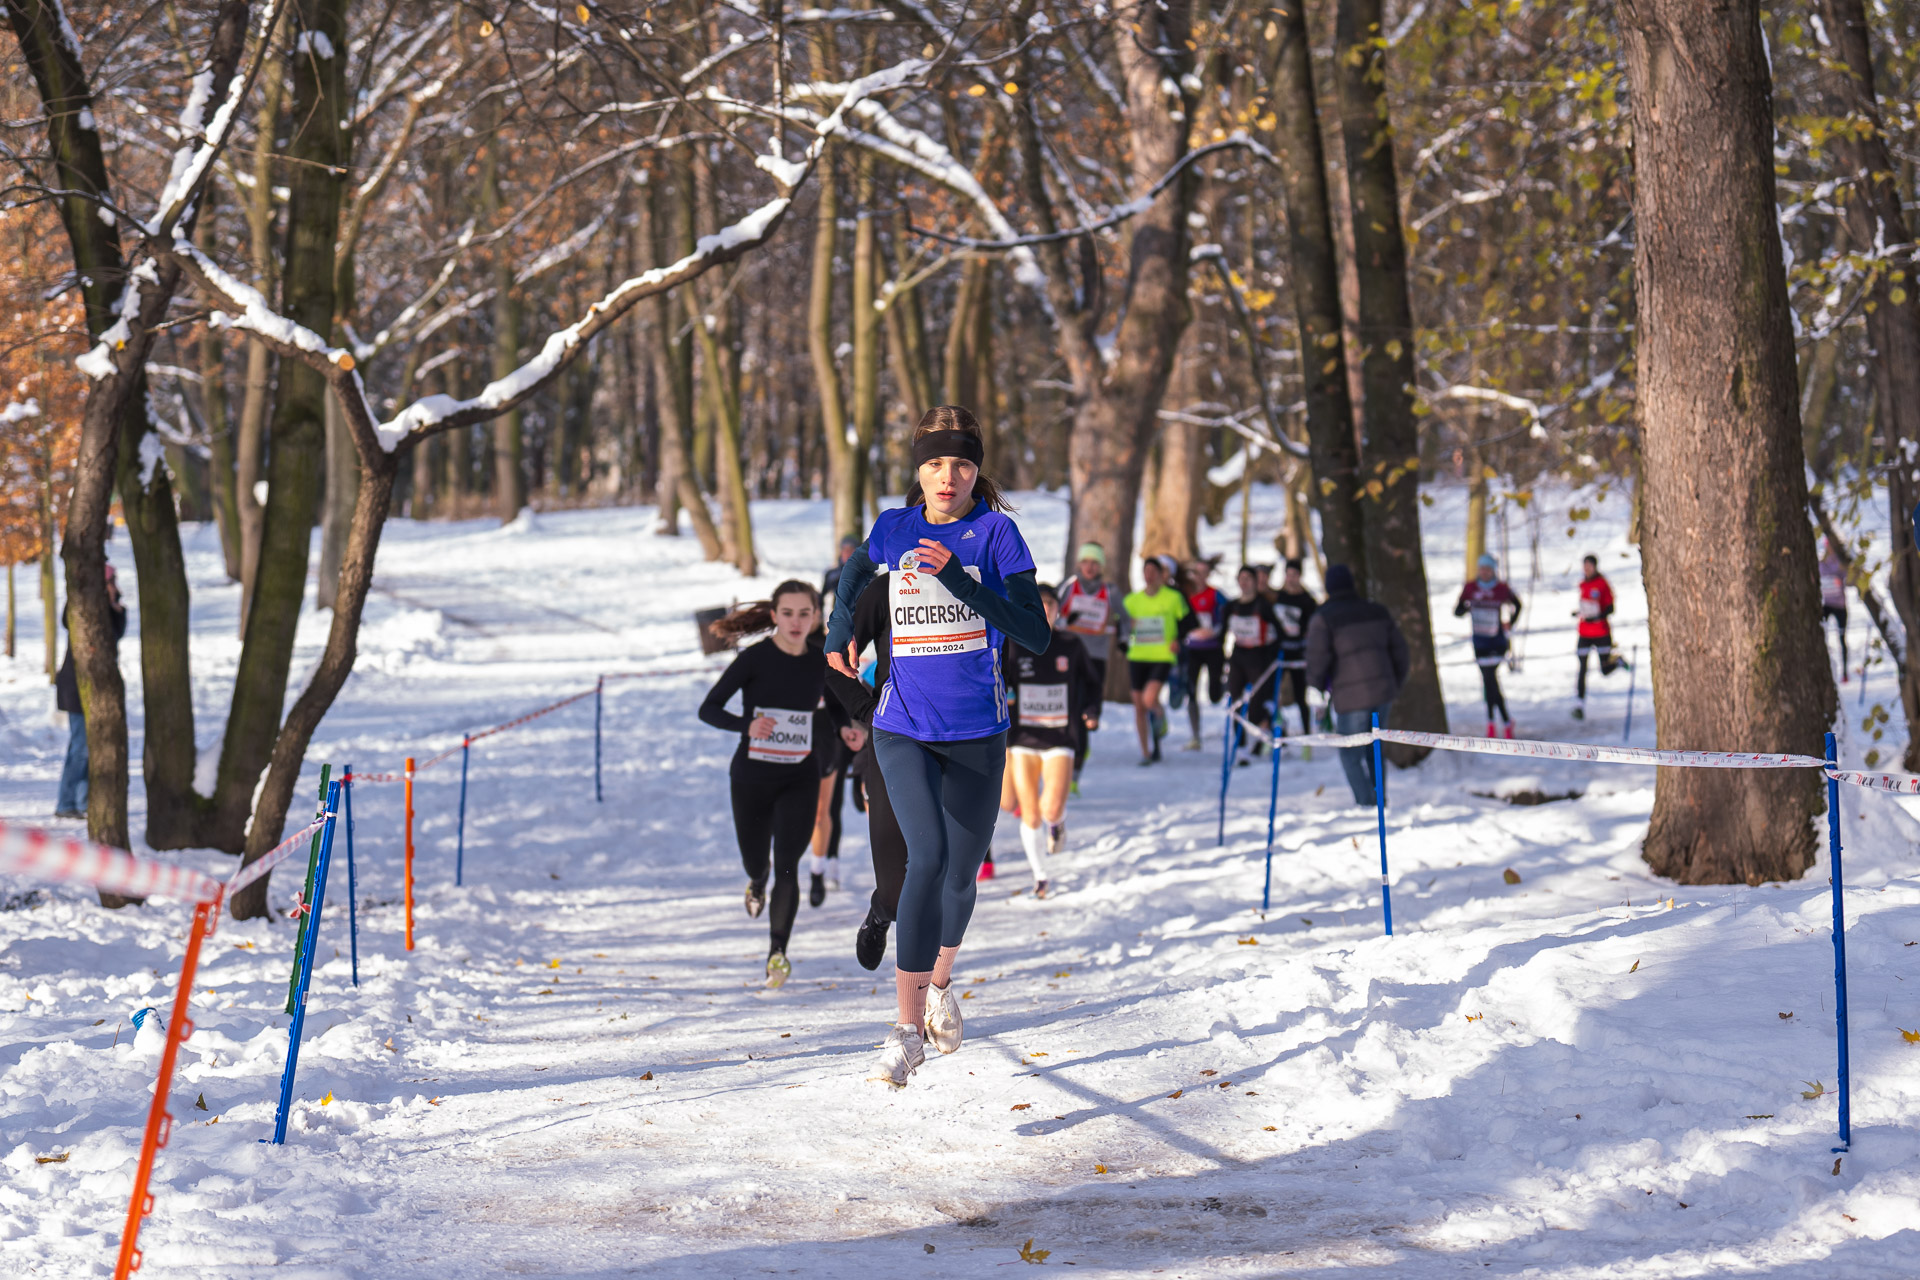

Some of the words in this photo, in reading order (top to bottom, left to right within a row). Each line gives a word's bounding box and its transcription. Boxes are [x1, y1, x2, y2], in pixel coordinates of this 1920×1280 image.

[895, 604, 979, 625] CIECIERSKA
[911, 645, 941, 653] BYTOM
[943, 643, 965, 652] 2024
[788, 714, 807, 726] 468
[754, 731, 808, 745] ROMIN
